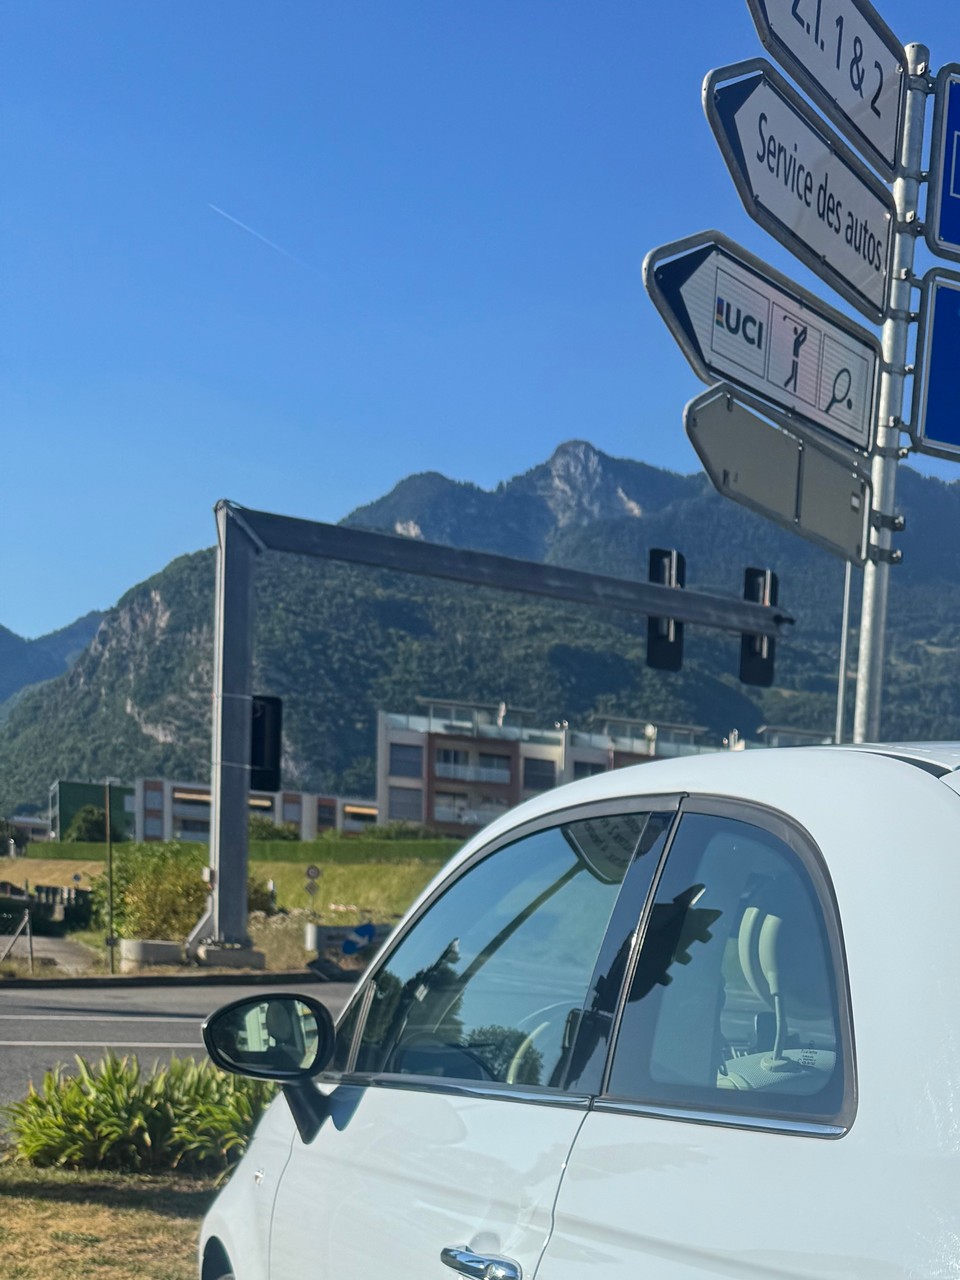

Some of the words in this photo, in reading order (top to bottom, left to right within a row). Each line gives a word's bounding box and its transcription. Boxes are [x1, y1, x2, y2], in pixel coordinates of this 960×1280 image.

[835, 15, 844, 70] 1
[850, 36, 865, 98] &
[870, 60, 884, 119] 2
[756, 112, 814, 207] Service
[817, 173, 842, 235] des
[845, 211, 882, 272] autos
[724, 301, 764, 350] UCI
